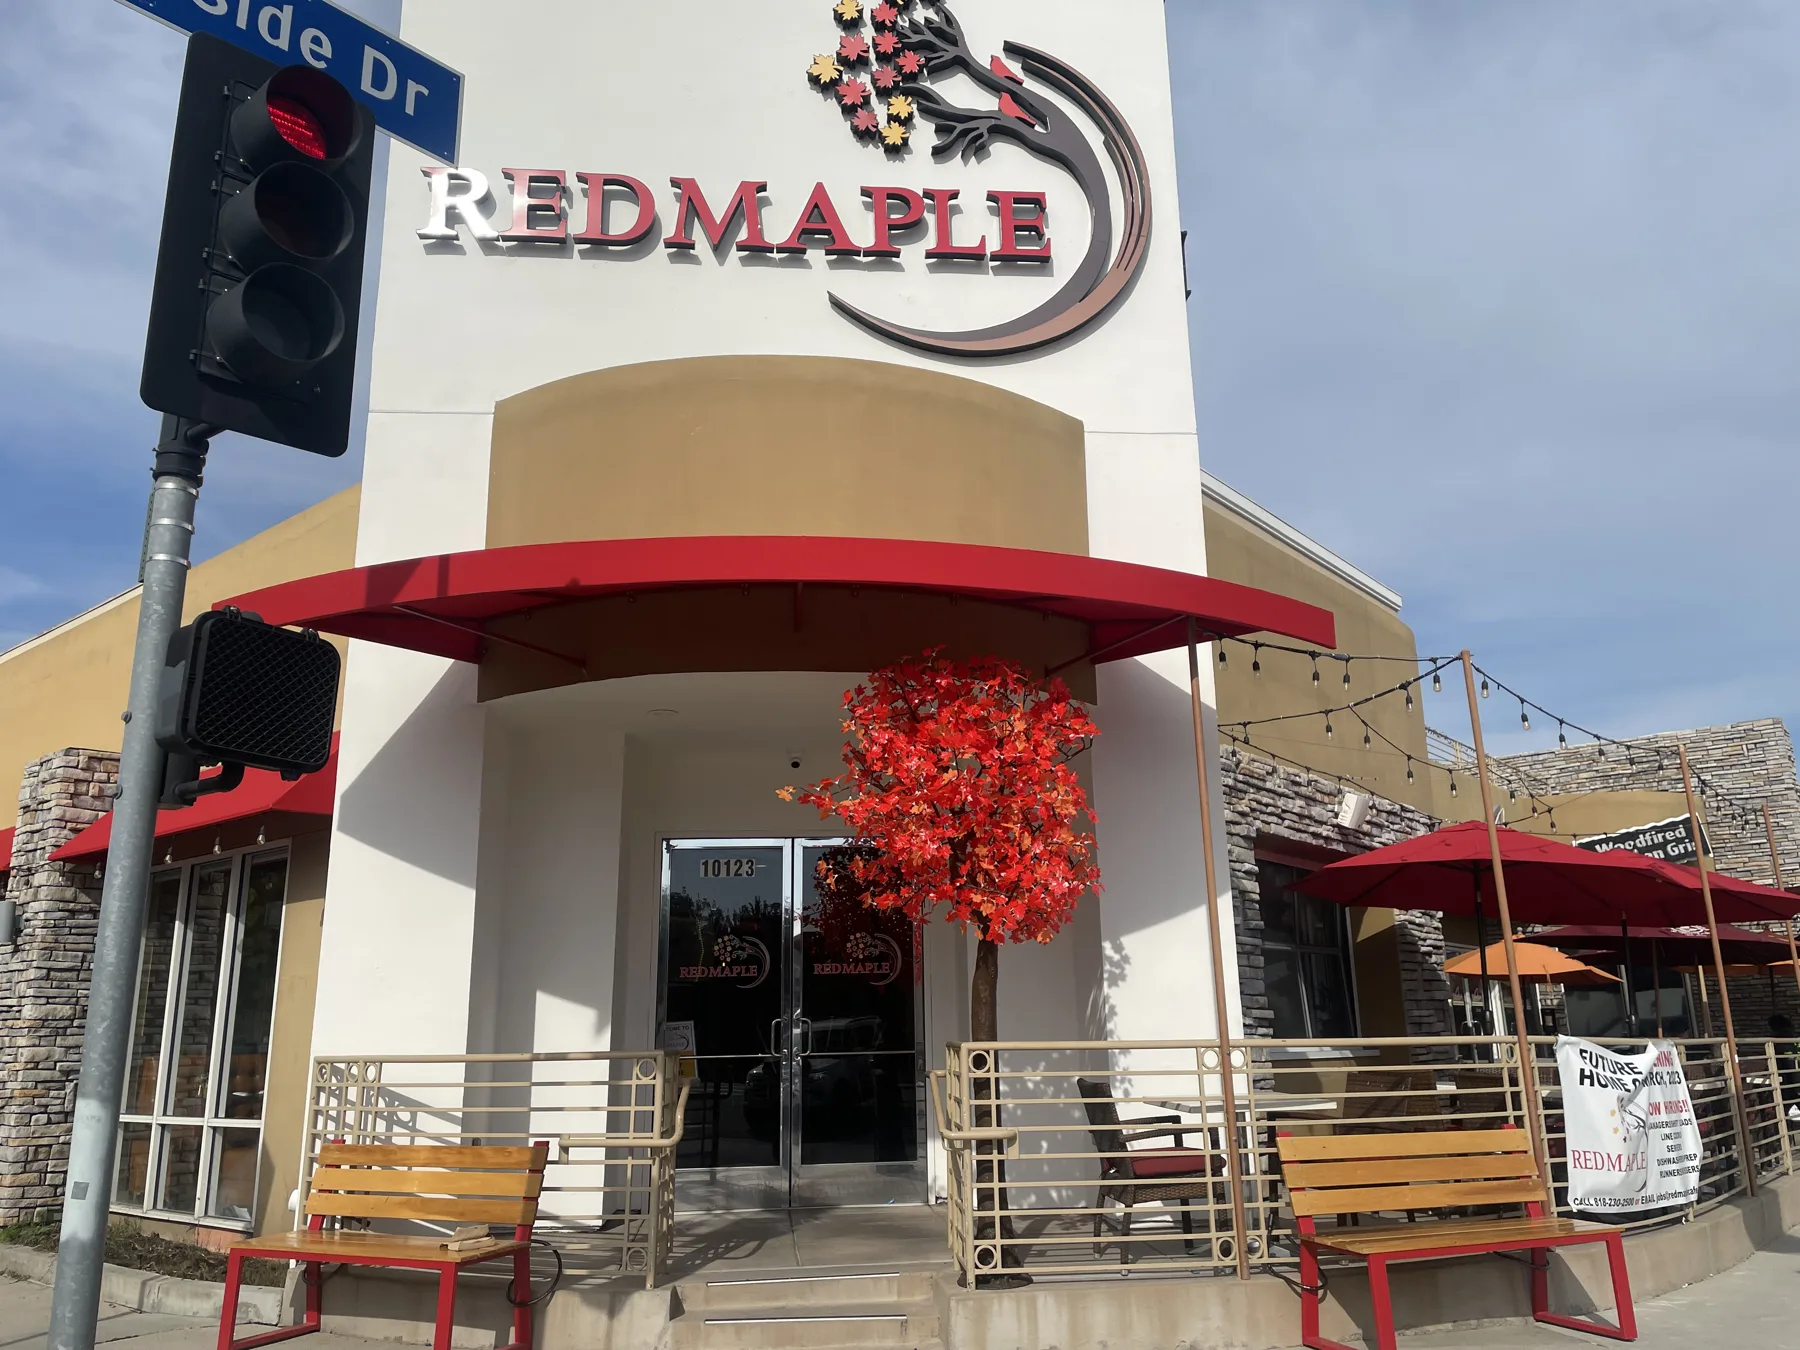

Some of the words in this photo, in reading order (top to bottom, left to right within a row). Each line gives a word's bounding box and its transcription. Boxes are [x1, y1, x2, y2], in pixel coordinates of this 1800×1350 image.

[360, 44, 430, 117] Dr
[416, 165, 1053, 263] REDMAPLE
[701, 859, 755, 878] 10123
[679, 964, 758, 978] REDMAPLE
[813, 962, 890, 975] REDMAPLE
[1580, 1048, 1643, 1076] FUTURE
[1579, 1067, 1632, 1093] HOME
[1648, 1101, 1660, 1116] OW
[1573, 1197, 1594, 1207] CALL
